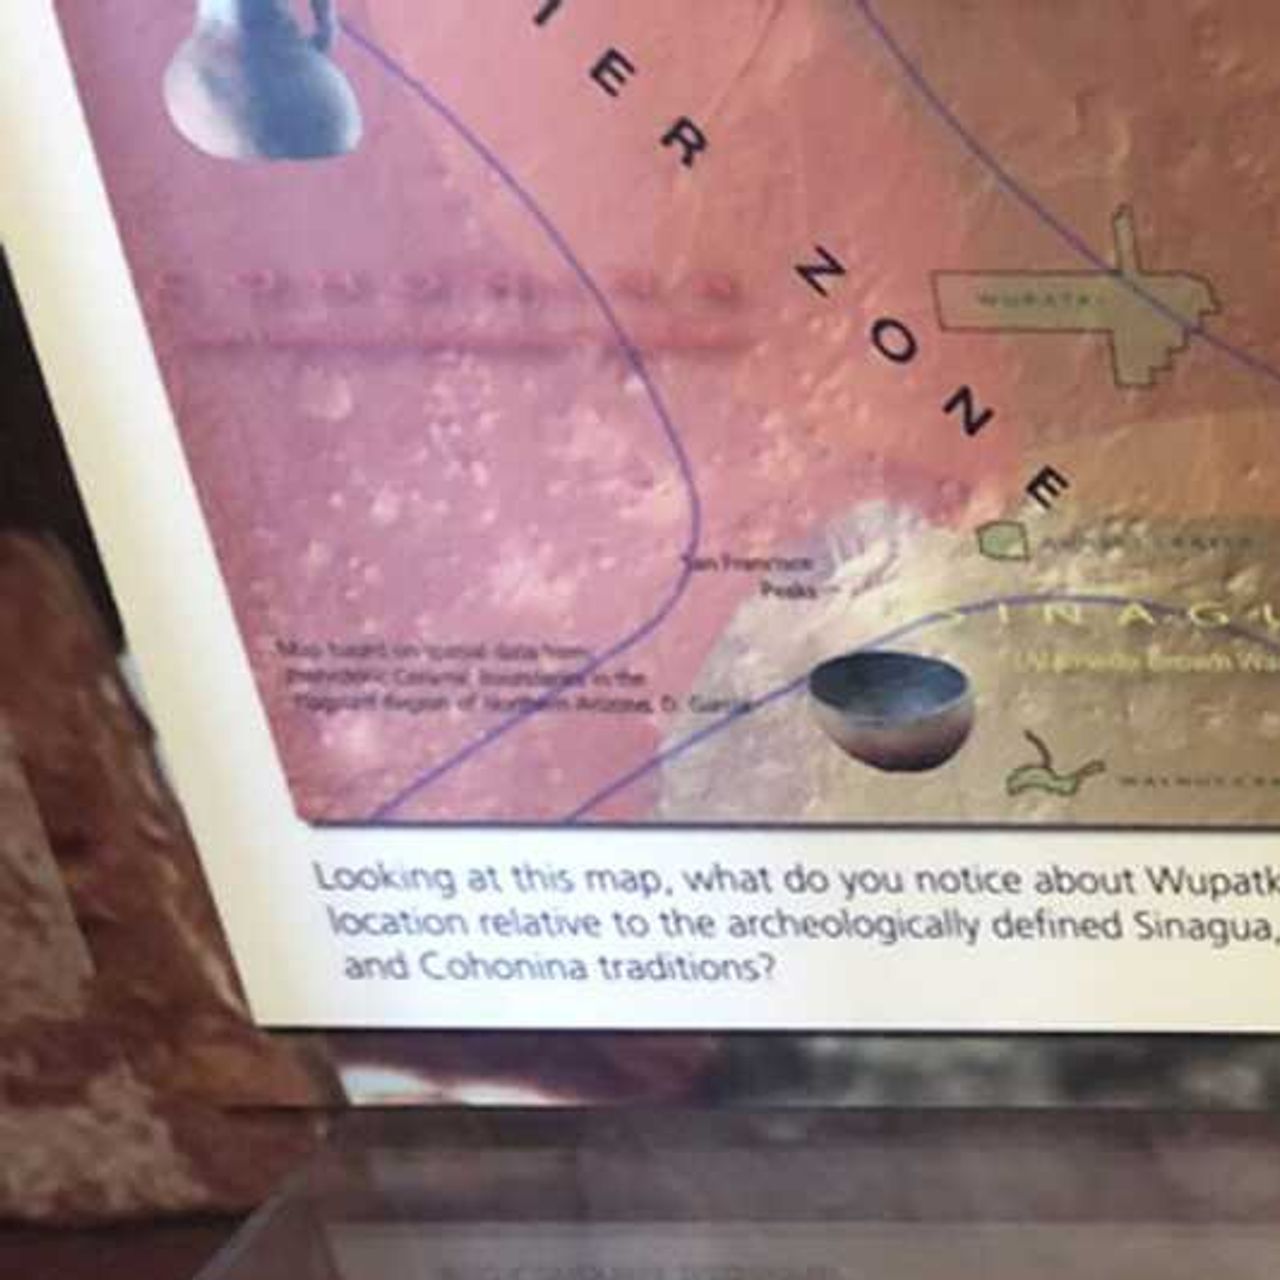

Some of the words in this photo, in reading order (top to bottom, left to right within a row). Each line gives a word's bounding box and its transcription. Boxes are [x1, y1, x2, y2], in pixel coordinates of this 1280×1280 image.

[796, 246, 1070, 508] ZONE
[312, 862, 456, 899] Looking
[468, 867, 502, 892] at
[511, 864, 574, 893] this
[585, 870, 673, 898] map,
[683, 864, 772, 893] what
[784, 864, 829, 893] do
[839, 870, 904, 900] you
[915, 868, 1021, 894] notice
[1035, 865, 1135, 895] about
[327, 905, 468, 936] location
[480, 909, 601, 937] relative
[612, 912, 650, 938] to
[659, 909, 715, 937] the
[729, 909, 980, 946] archeologically
[992, 908, 1123, 940] defined
[345, 954, 409, 979] and
[419, 951, 588, 980] Cohonina
[598, 952, 775, 982] traditions?
